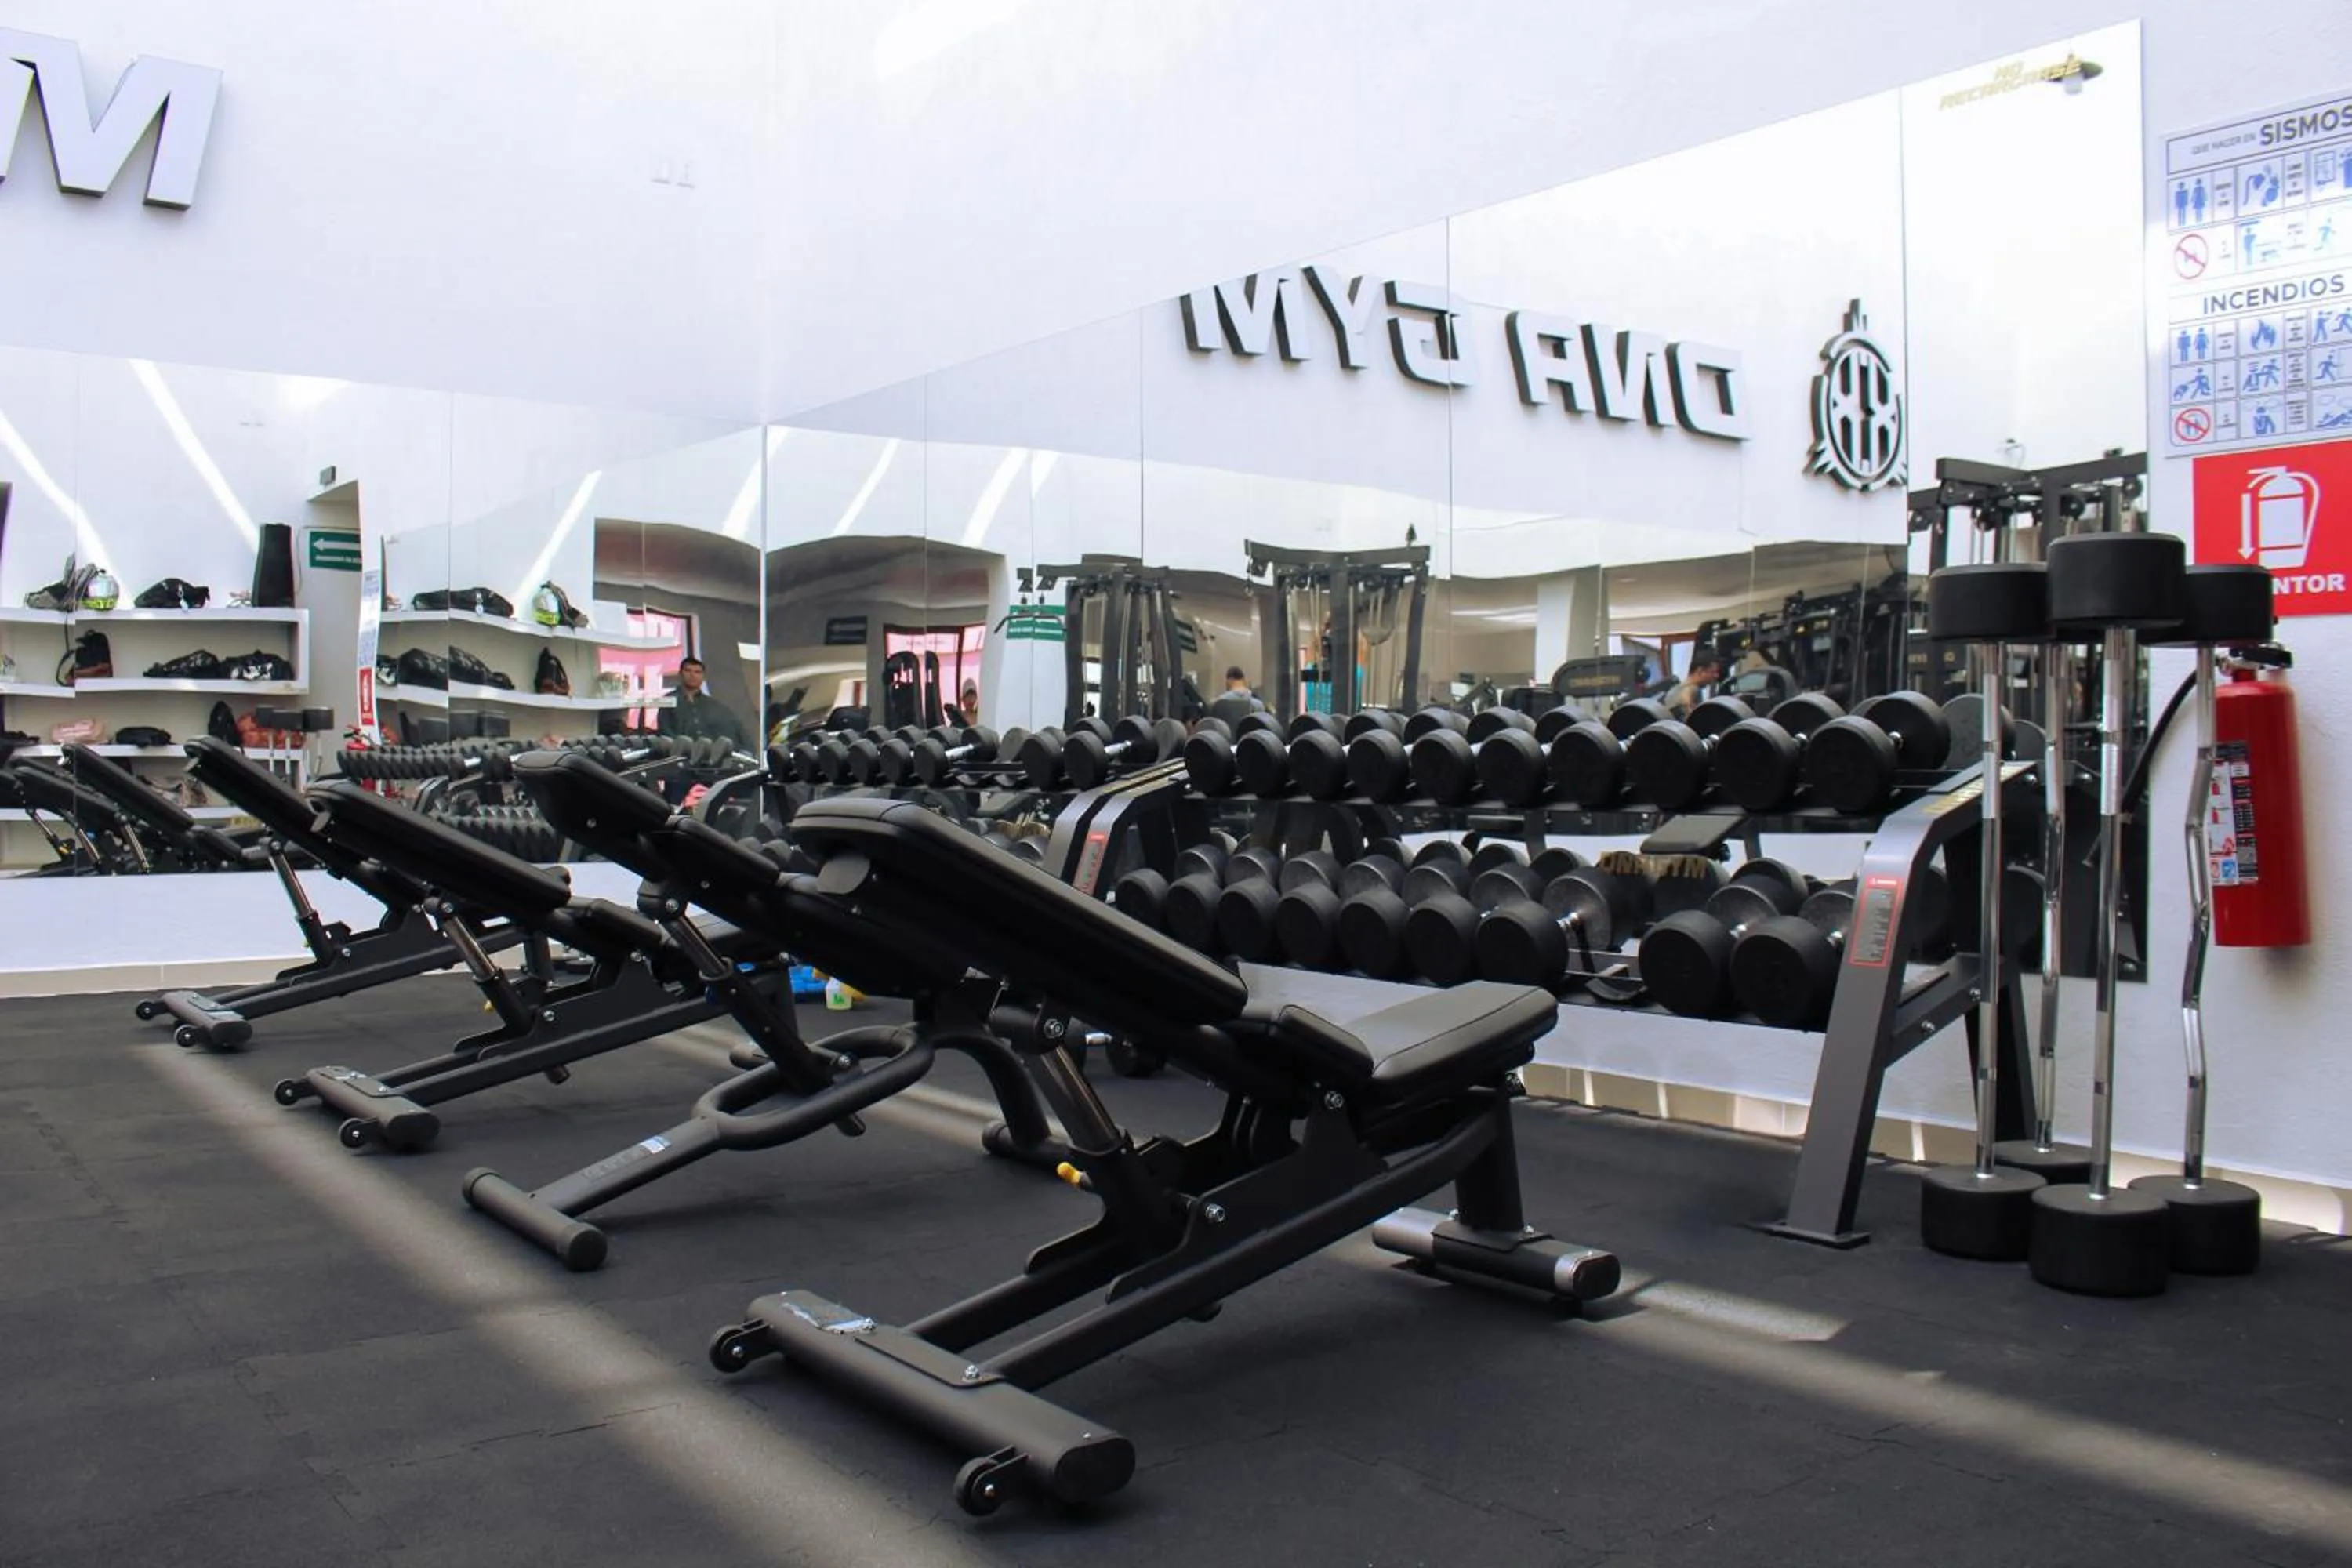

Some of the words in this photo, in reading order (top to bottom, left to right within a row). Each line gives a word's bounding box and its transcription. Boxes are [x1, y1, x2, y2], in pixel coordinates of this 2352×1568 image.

[2259, 104, 2352, 146] SISMOS
[2203, 274, 2345, 314] INCENDIOS
[2272, 574, 2346, 595] NTOR
